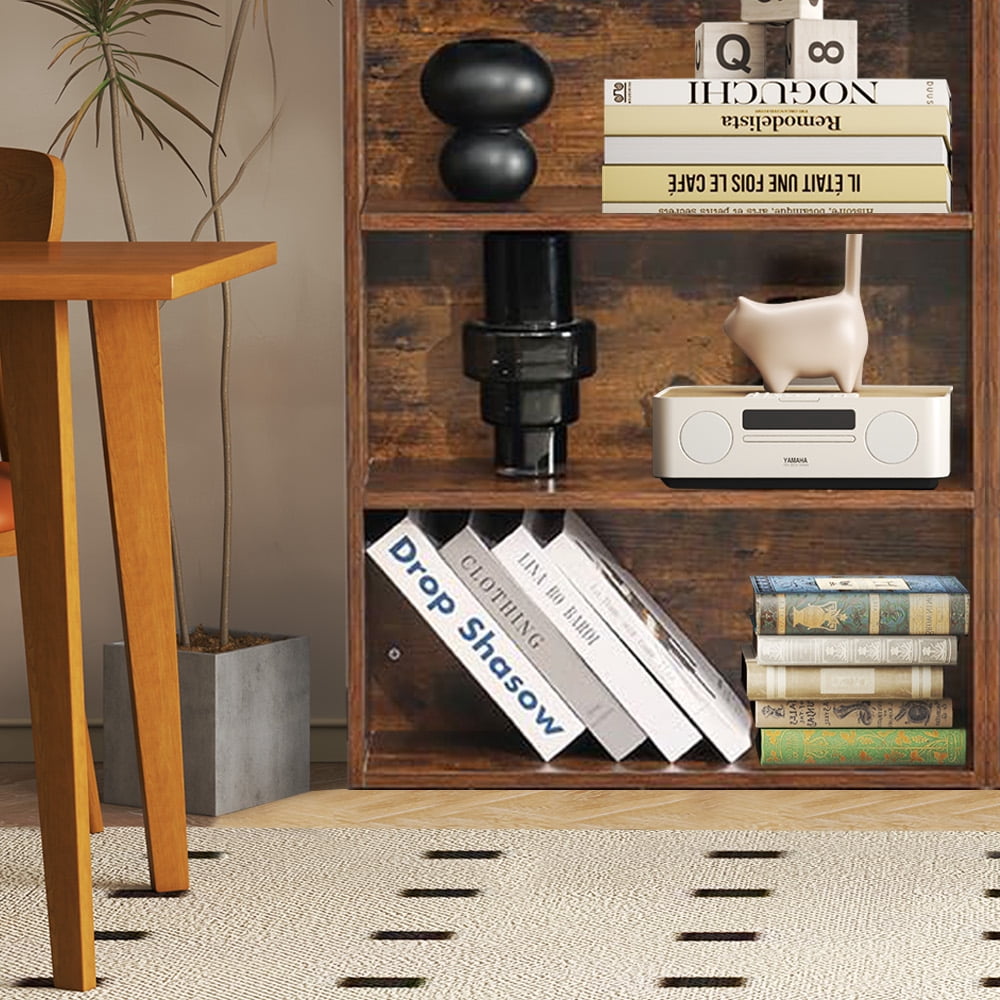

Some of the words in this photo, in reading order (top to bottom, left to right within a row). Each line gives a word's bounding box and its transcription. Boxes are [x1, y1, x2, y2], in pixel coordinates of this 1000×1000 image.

[716, 33, 752, 74] Q
[808, 40, 845, 65] 8
[689, 81, 878, 104] NOGUCHI
[721, 115, 841, 132] Remodelista
[667, 173, 706, 197] CAFÉ
[709, 173, 727, 193] LE
[731, 173, 764, 193] FOIS
[768, 173, 798, 193] UNE
[801, 173, 843, 197] ÉTAIT
[847, 173, 861, 193] IL
[783, 456, 809, 464] YAMAHA
[460, 554, 546, 650] CLOTHING
[388, 535, 456, 616] Drop
[458, 616, 564, 736] Shasow
